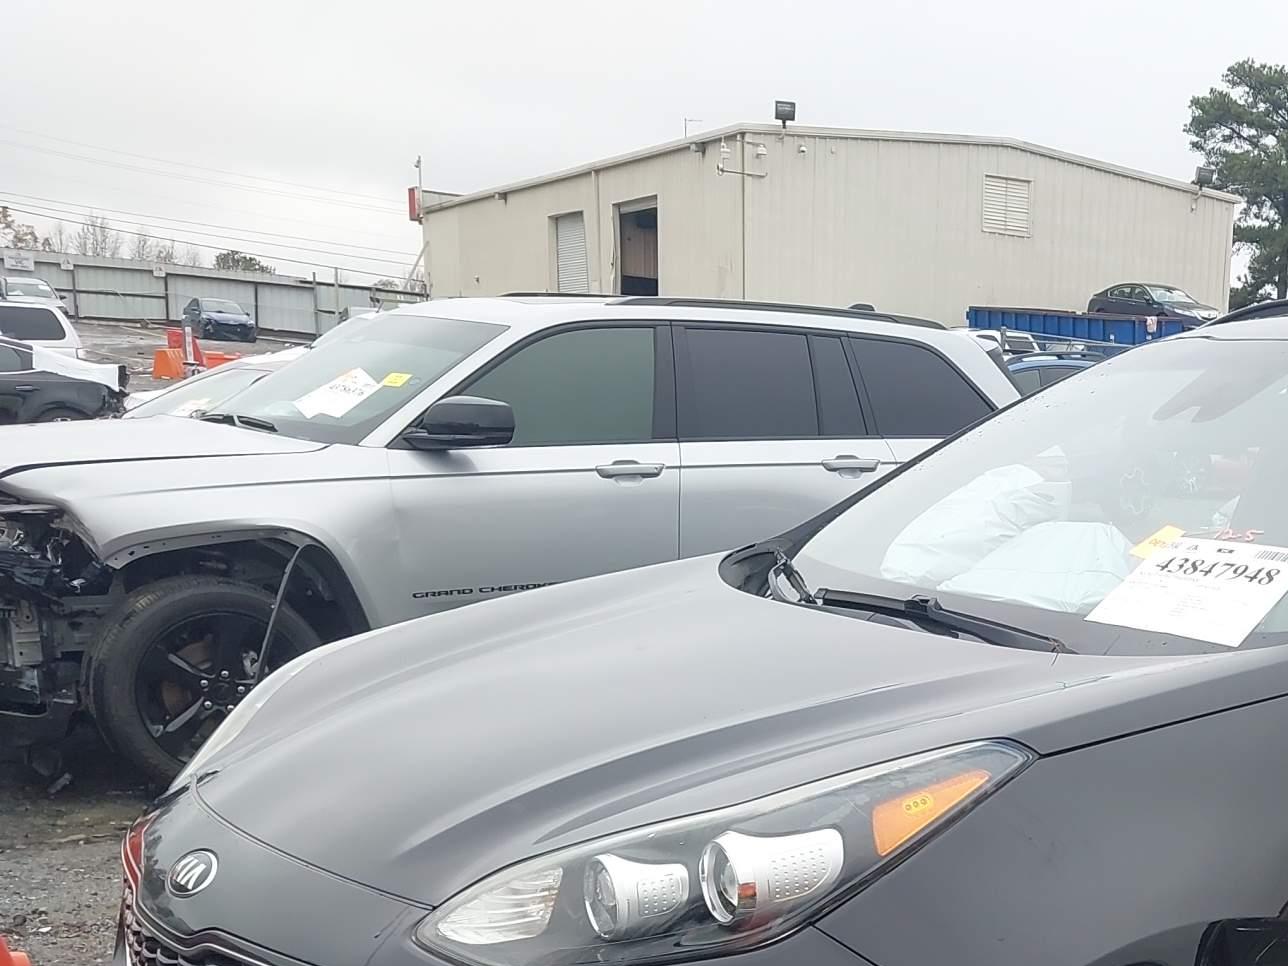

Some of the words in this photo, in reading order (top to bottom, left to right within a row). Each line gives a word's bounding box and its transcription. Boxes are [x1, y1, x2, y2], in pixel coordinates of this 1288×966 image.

[1155, 556, 1281, 586] 43847948
[412, 588, 473, 599] GRAND
[172, 855, 207, 890] KIA
